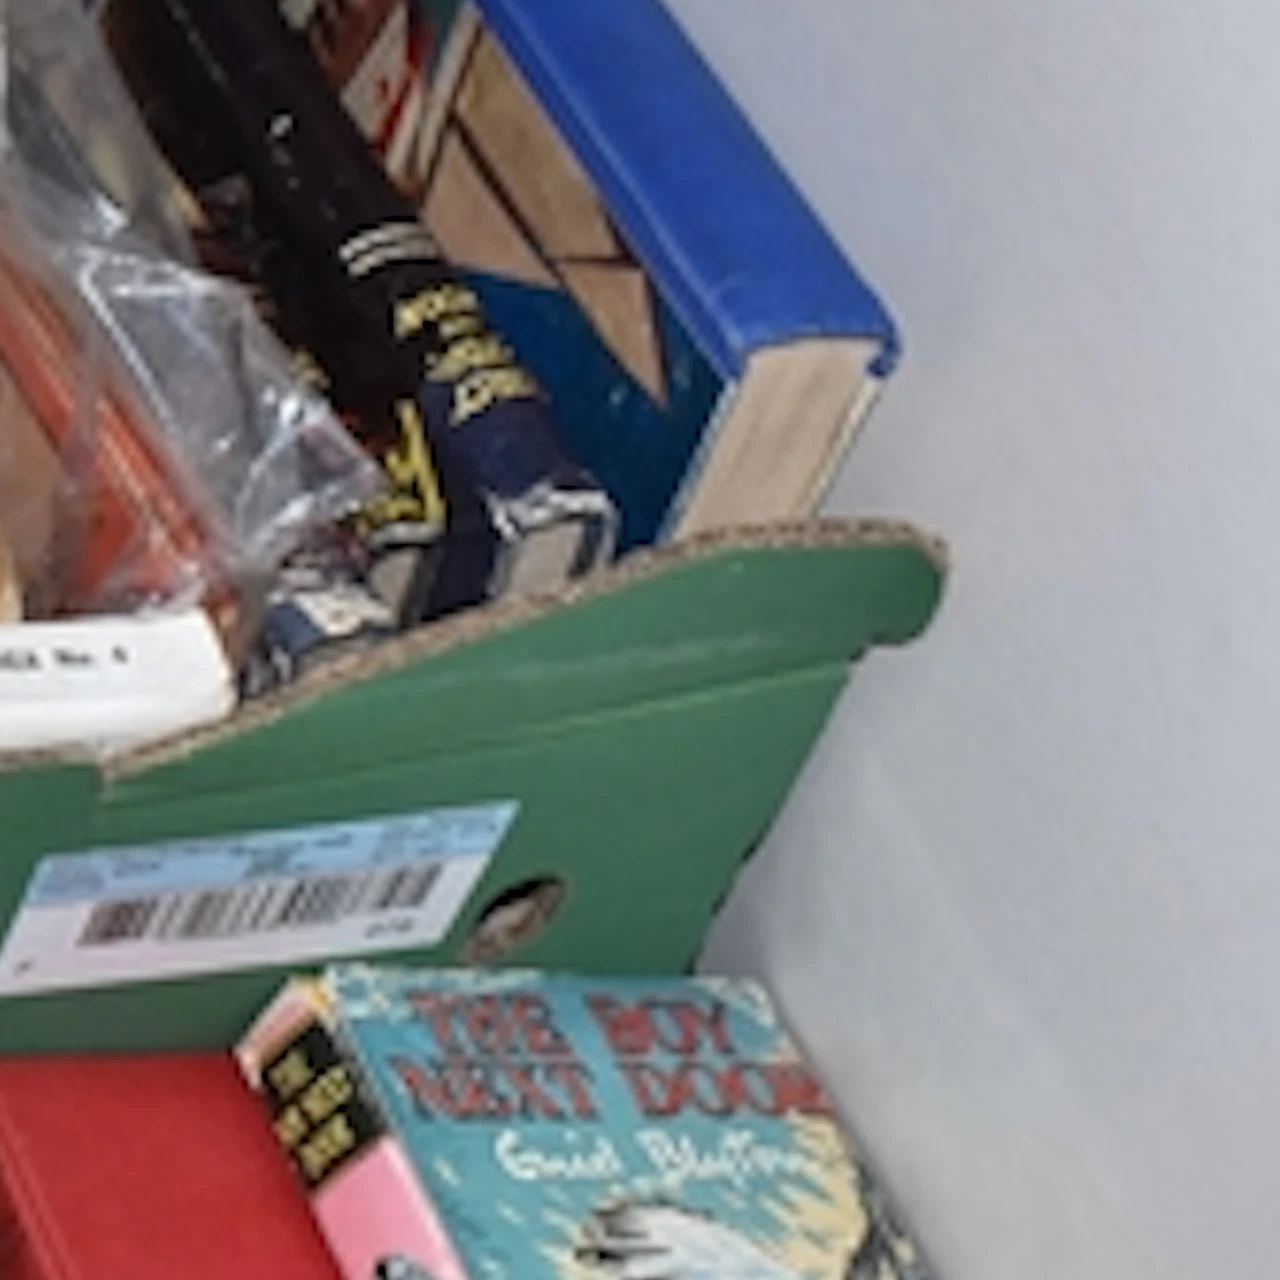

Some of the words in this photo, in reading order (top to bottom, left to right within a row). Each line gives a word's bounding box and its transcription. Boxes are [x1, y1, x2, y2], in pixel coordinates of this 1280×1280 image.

[406, 989, 573, 1056] THE
[584, 993, 735, 1056] BOY
[389, 1055, 598, 1120] NEXT
[617, 1059, 837, 1120] DOOR
